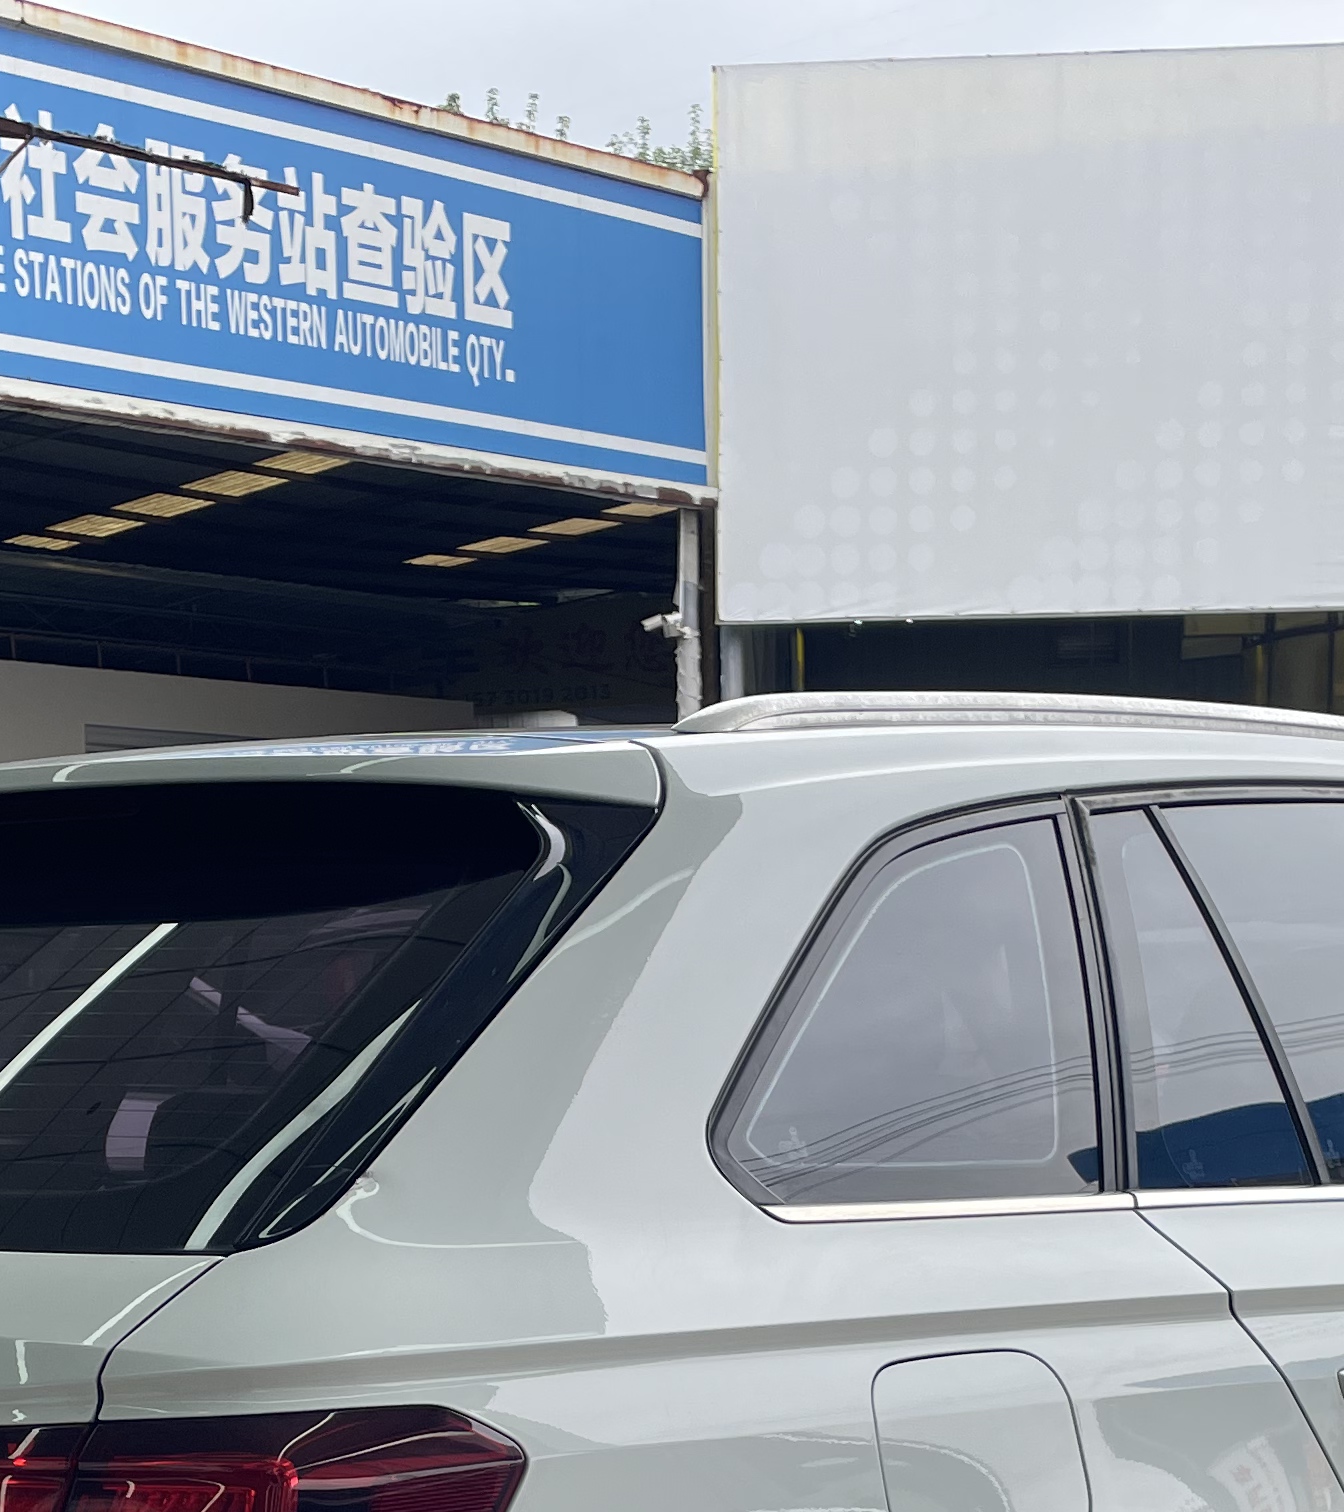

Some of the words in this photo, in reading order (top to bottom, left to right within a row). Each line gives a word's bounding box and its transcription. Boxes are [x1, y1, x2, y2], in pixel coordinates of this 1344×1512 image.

[14, 251, 132, 317] STATIONS
[138, 273, 169, 322] OF
[175, 279, 221, 332] THE
[226, 291, 327, 351] WESTERN
[334, 309, 460, 374] AUTOMOBILE
[466, 331, 515, 387] QTY.
